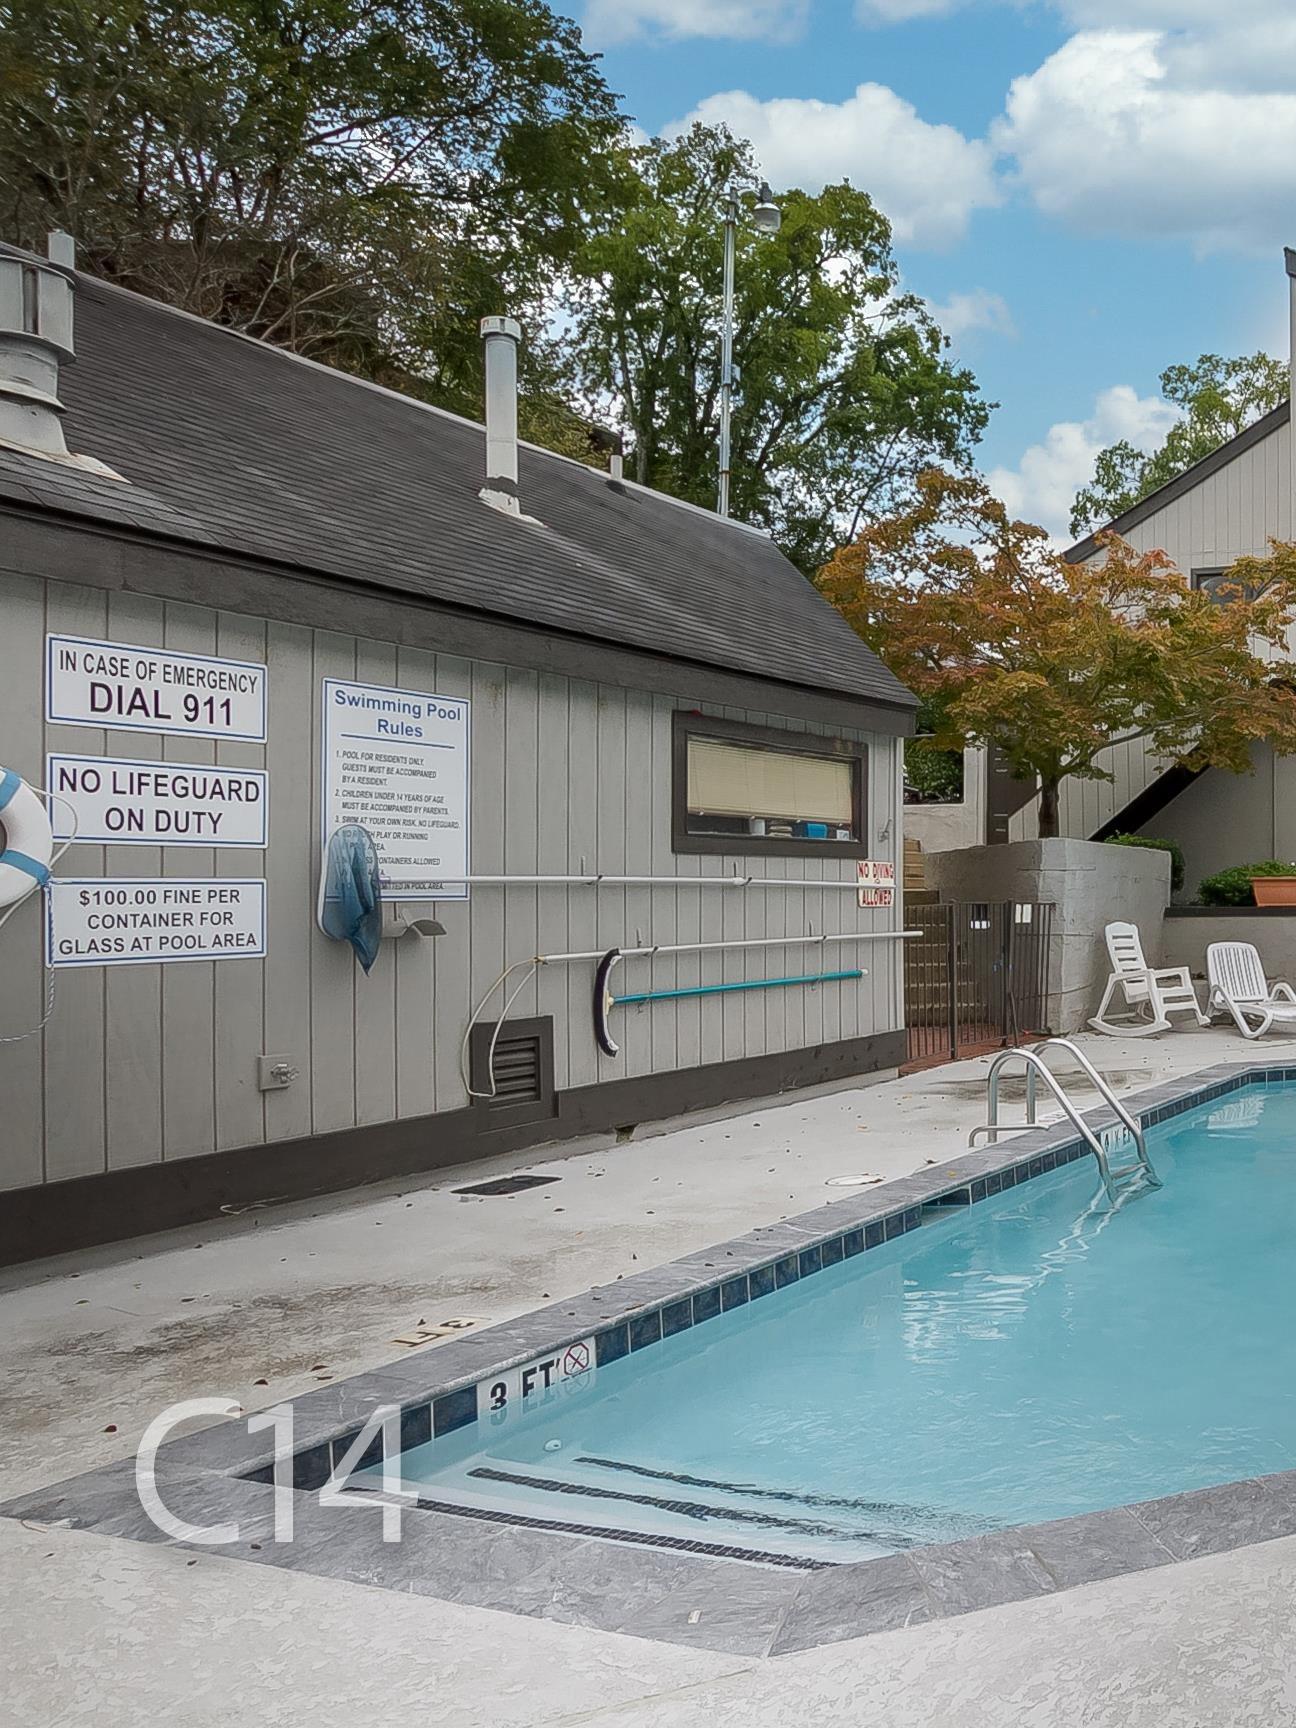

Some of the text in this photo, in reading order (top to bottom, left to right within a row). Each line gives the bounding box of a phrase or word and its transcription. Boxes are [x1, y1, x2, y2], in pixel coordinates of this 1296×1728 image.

[59, 649, 258, 694] IN CASE OF EMERGENCY
[90, 681, 231, 726] DIAL 911
[335, 689, 460, 721] Swimming Pool
[377, 719, 423, 738] Rules
[342, 750, 360, 760] POOL
[360, 751, 374, 761] FOR
[374, 753, 408, 765] RESIDENTS
[342, 762, 367, 773] GUESTS
[368, 765, 386, 774] MUST
[396, 768, 437, 779] ACCOMPANIED
[59, 767, 260, 802] NO LIFEGUARD
[341, 789, 373, 799] CHILDREN
[374, 791, 396, 801] UNDER
[403, 793, 423, 803] YEARS
[341, 801, 360, 810] MUST
[370, 803, 413, 814] ACCOMPANIED
[105, 807, 223, 834] ON DUTY
[368, 817, 386, 825] YOUR
[376, 831, 392, 840] PLAY
[377, 856, 412, 865] ONTAINERS
[79, 889, 241, 907] $100.00 FINE PER
[87, 911, 234, 930] CONTAINER FOR
[59, 933, 257, 955] GLASS AT POOL AREA
[490, 1382, 507, 1411] 3
